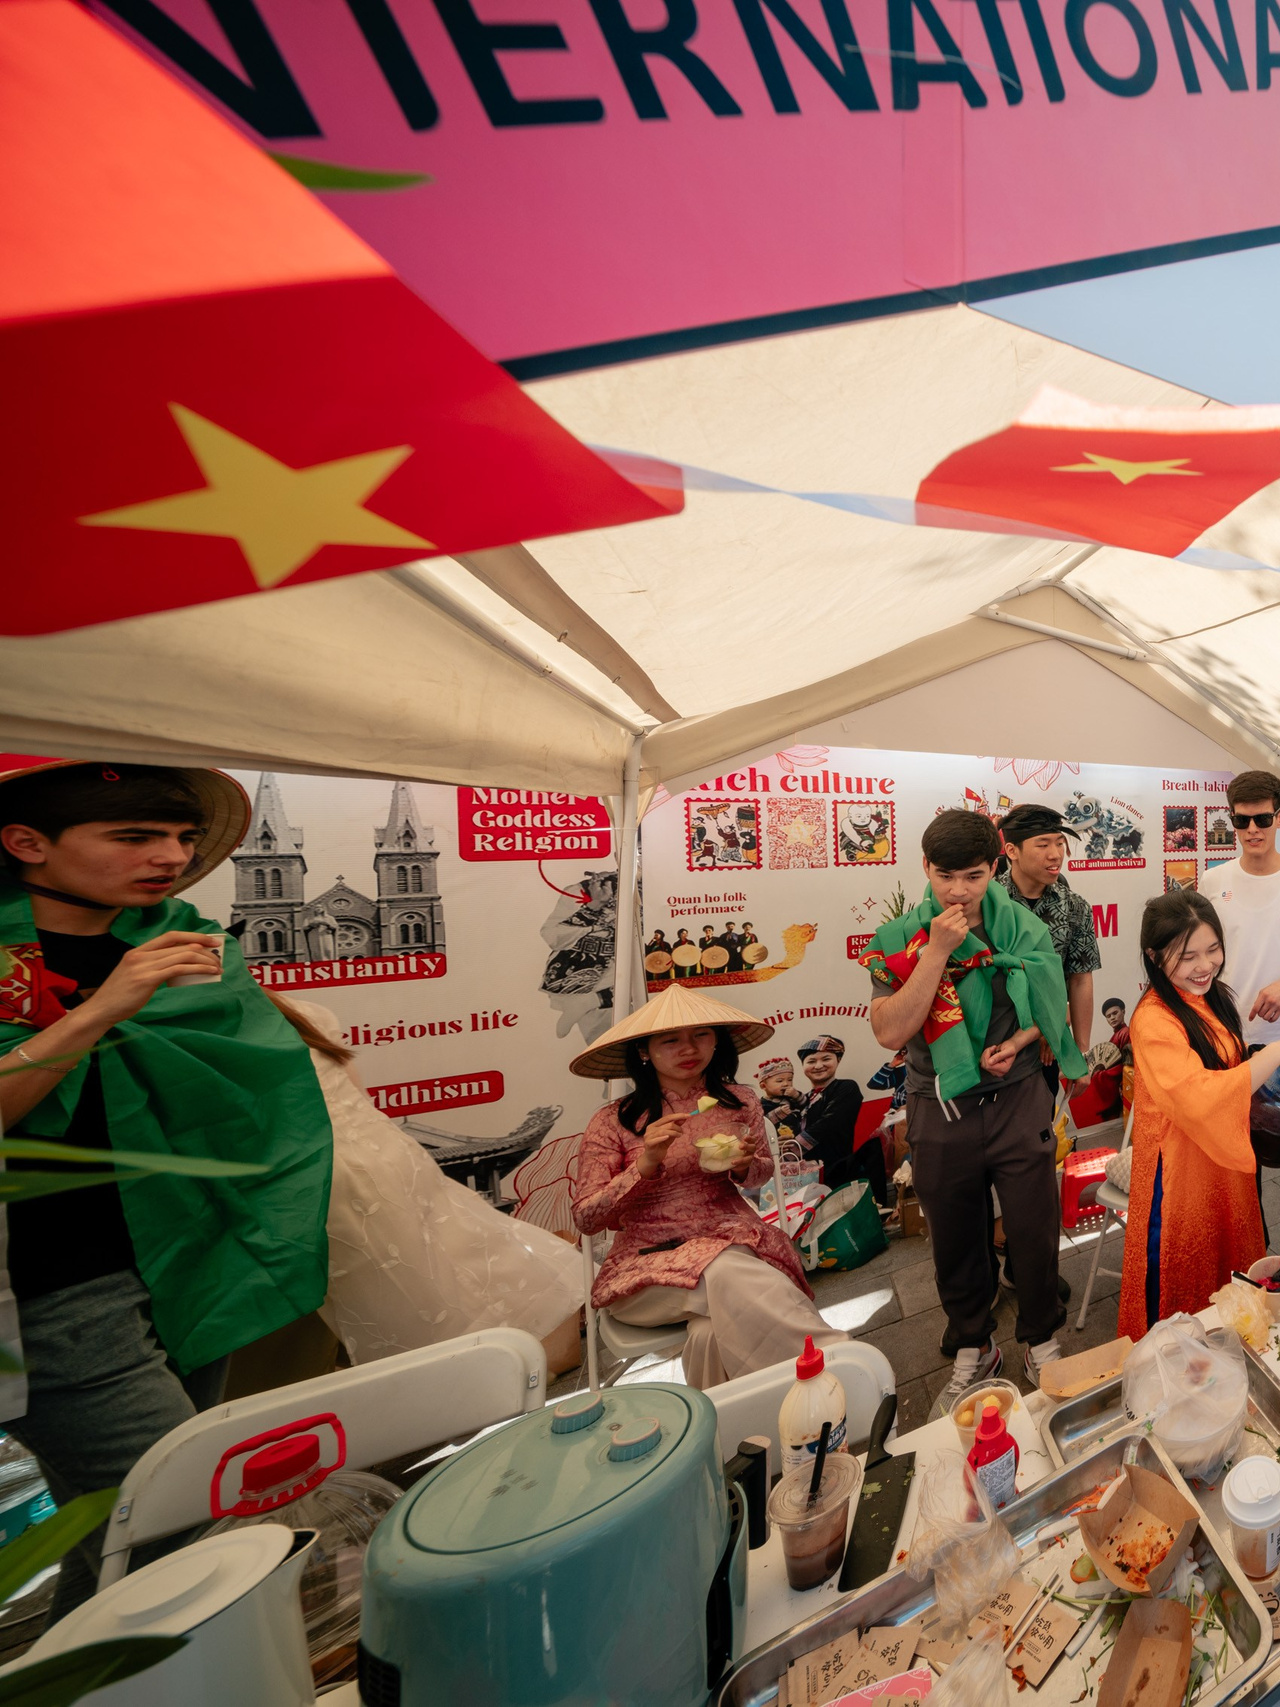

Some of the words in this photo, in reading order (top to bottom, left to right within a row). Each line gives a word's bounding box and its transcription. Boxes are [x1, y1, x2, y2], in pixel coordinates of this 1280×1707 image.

[779, 769, 896, 795] culture
[1162, 779, 1228, 792] Breath-taki
[472, 809, 597, 828] Goddess
[1110, 796, 1126, 808] Lion
[1126, 804, 1145, 821] dance
[473, 831, 599, 854] Religion
[1117, 858, 1143, 867] festival
[667, 895, 701, 906] Quan
[724, 892, 747, 903] folk
[670, 904, 745, 918] performace
[763, 1009, 795, 1026] nic
[799, 1002, 871, 1022] minorit
[341, 1019, 463, 1047] ligious
[470, 1009, 519, 1033] life
[371, 1078, 491, 1111] ddhism
[863, 1683, 887, 1694] LOVELY
